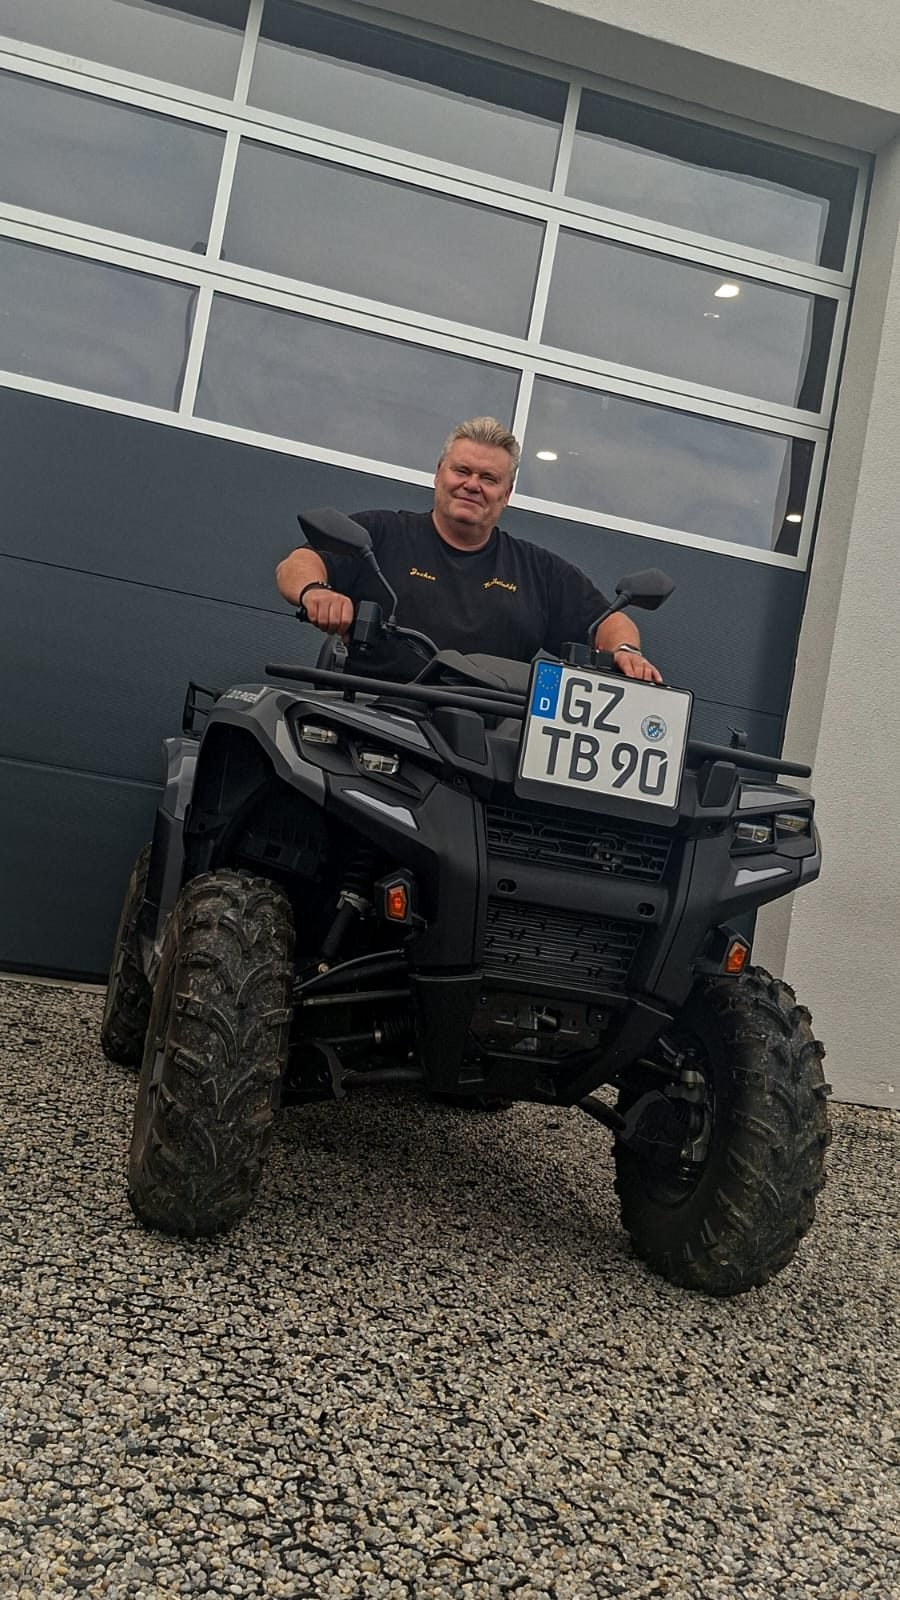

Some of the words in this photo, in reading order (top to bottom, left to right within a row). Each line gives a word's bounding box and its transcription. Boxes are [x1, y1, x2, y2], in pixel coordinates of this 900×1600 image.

[540, 697, 550, 711] D
[562, 677, 625, 734] GZ
[542, 726, 600, 782] TB
[611, 742, 668, 796] 90
